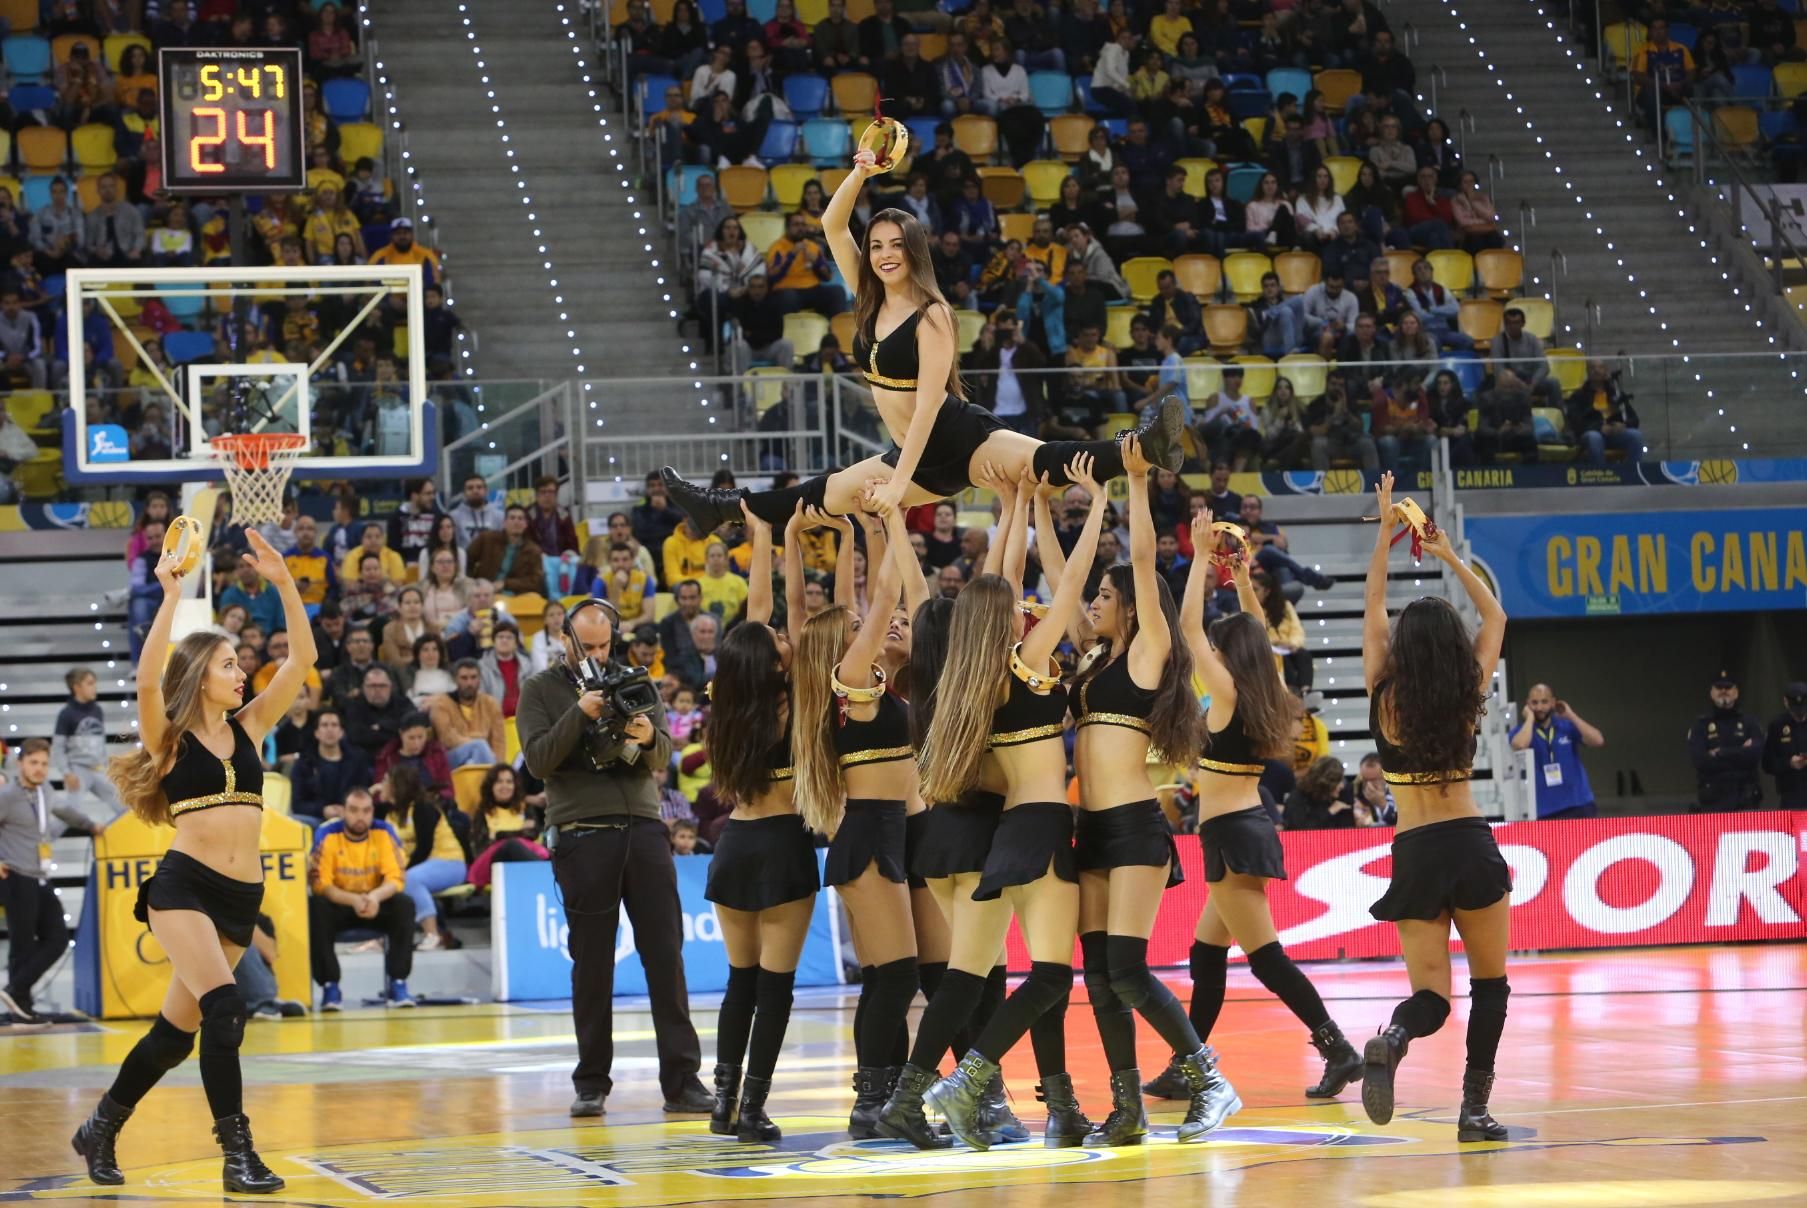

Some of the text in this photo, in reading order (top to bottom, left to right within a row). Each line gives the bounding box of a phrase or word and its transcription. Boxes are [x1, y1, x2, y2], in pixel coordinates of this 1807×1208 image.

[200, 64, 284, 101] 5:47
[190, 107, 275, 173] 24
[1457, 469, 1513, 487] CANARIA
[1546, 530, 1807, 597] GRAN CANA
[1176, 823, 1807, 964] SPOR
